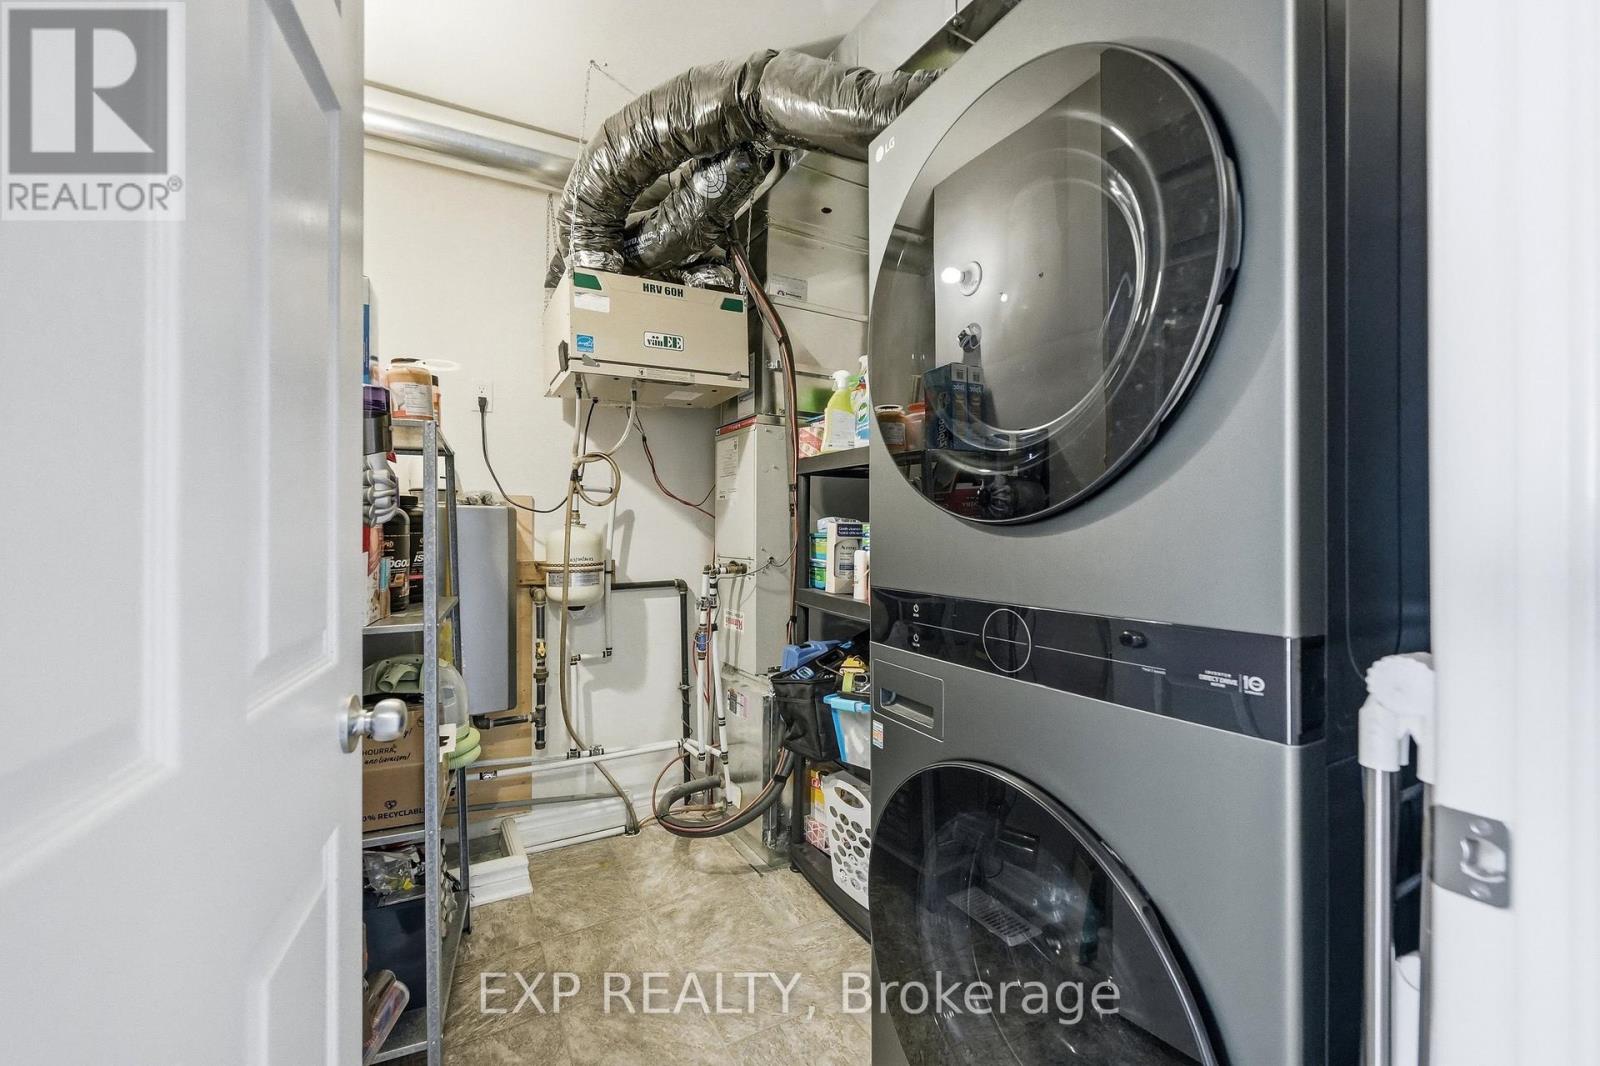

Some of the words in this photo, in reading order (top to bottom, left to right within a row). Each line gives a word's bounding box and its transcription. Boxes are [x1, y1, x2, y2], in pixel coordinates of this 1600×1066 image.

[884, 136, 895, 154] LG
[643, 283, 662, 294] HRV
[664, 287, 684, 298] 60H
[377, 808, 424, 820] RECYCLABL
